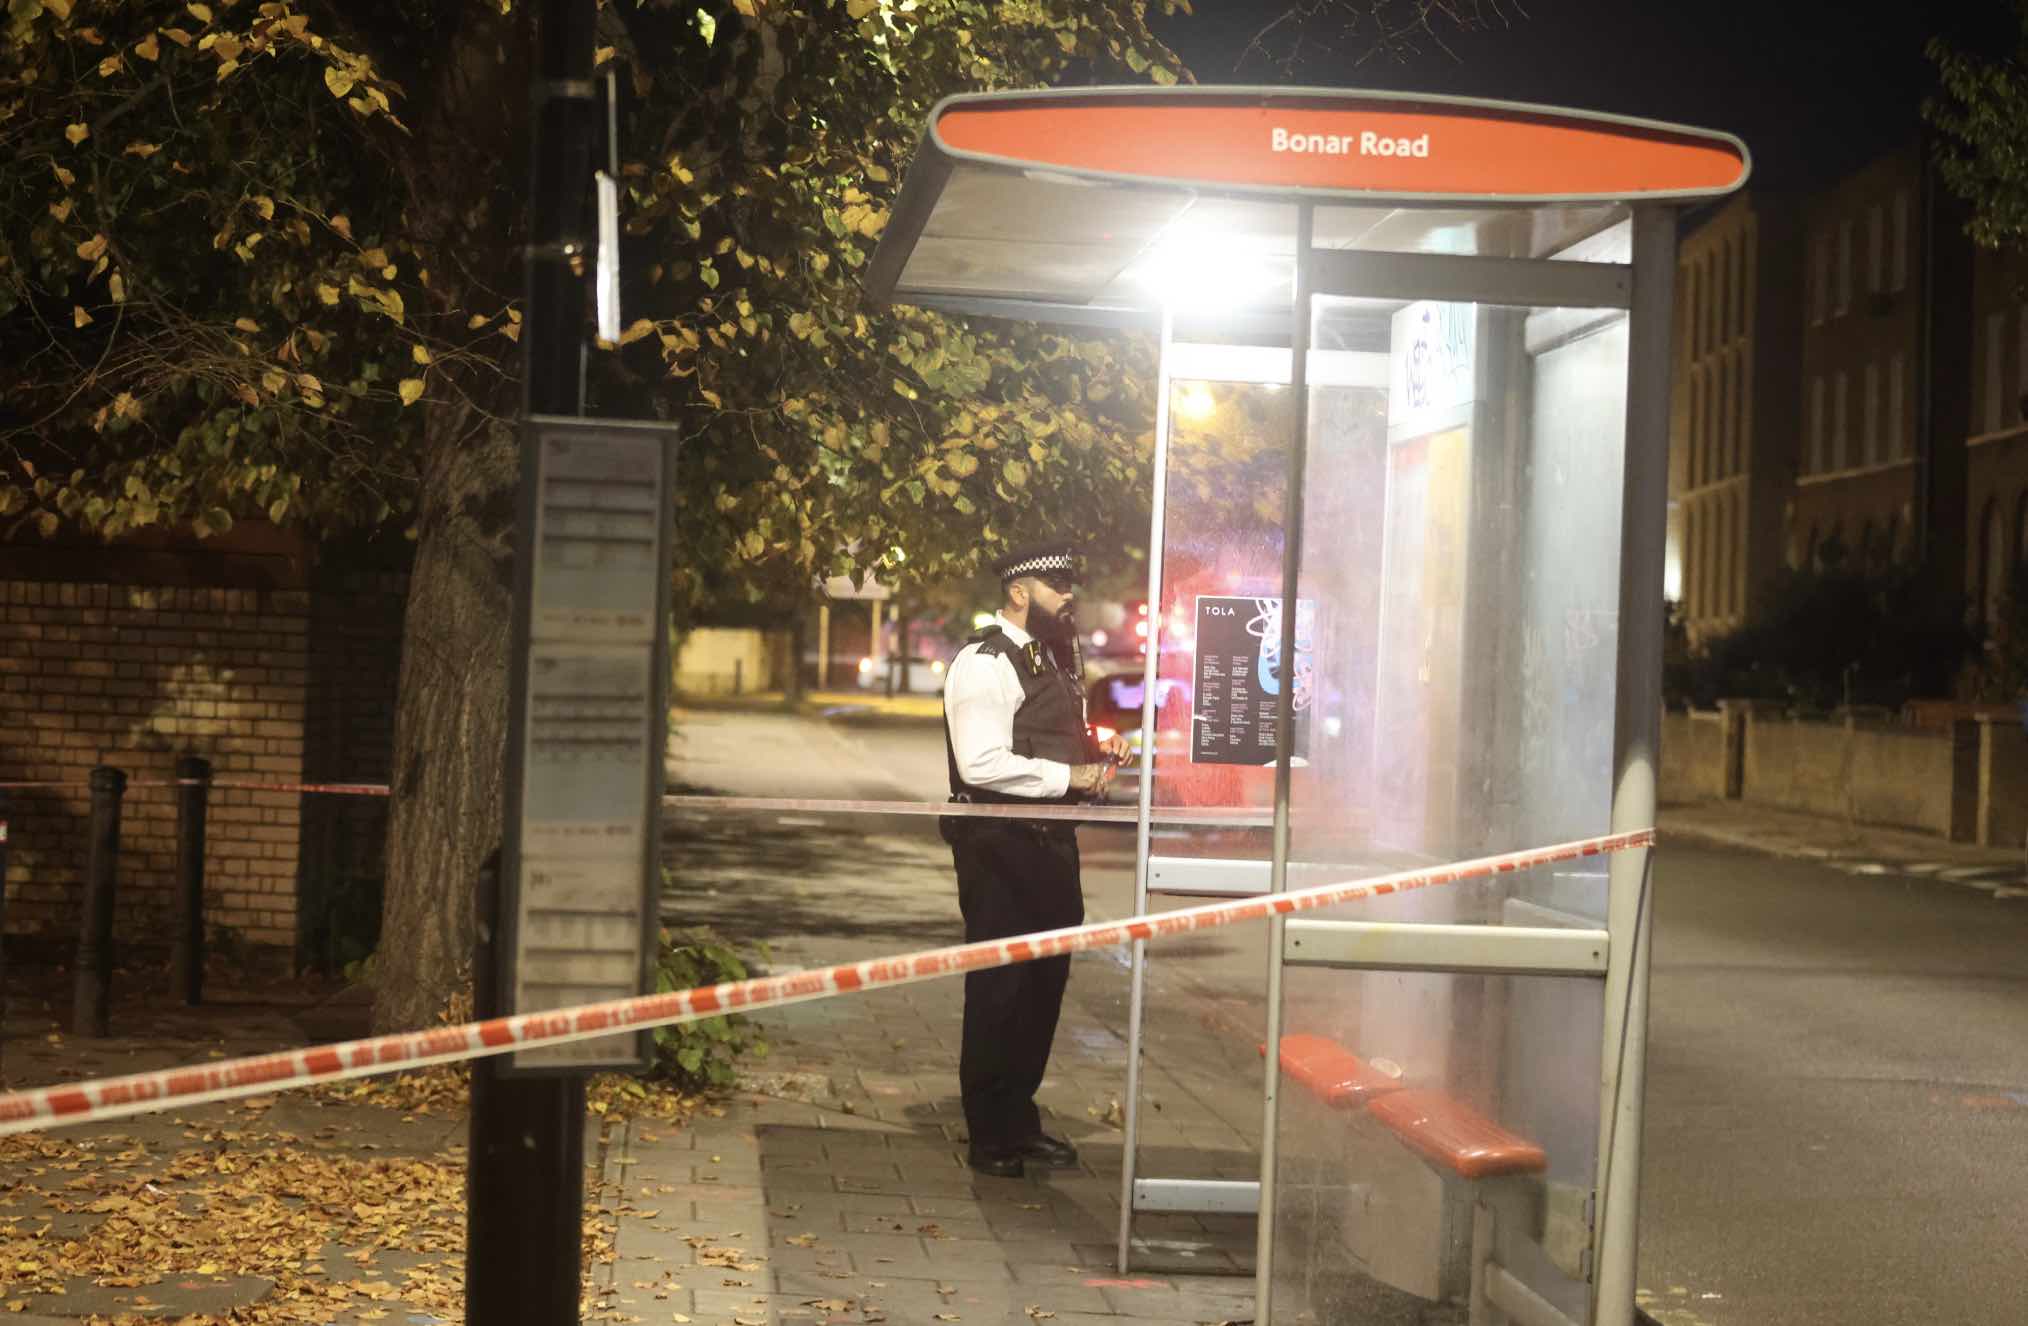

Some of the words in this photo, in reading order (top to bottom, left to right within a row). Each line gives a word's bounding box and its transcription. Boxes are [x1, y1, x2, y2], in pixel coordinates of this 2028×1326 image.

[1271, 127, 1353, 155] Bonar
[1360, 131, 1430, 158] Road
[1205, 606, 1235, 616] TOLA
